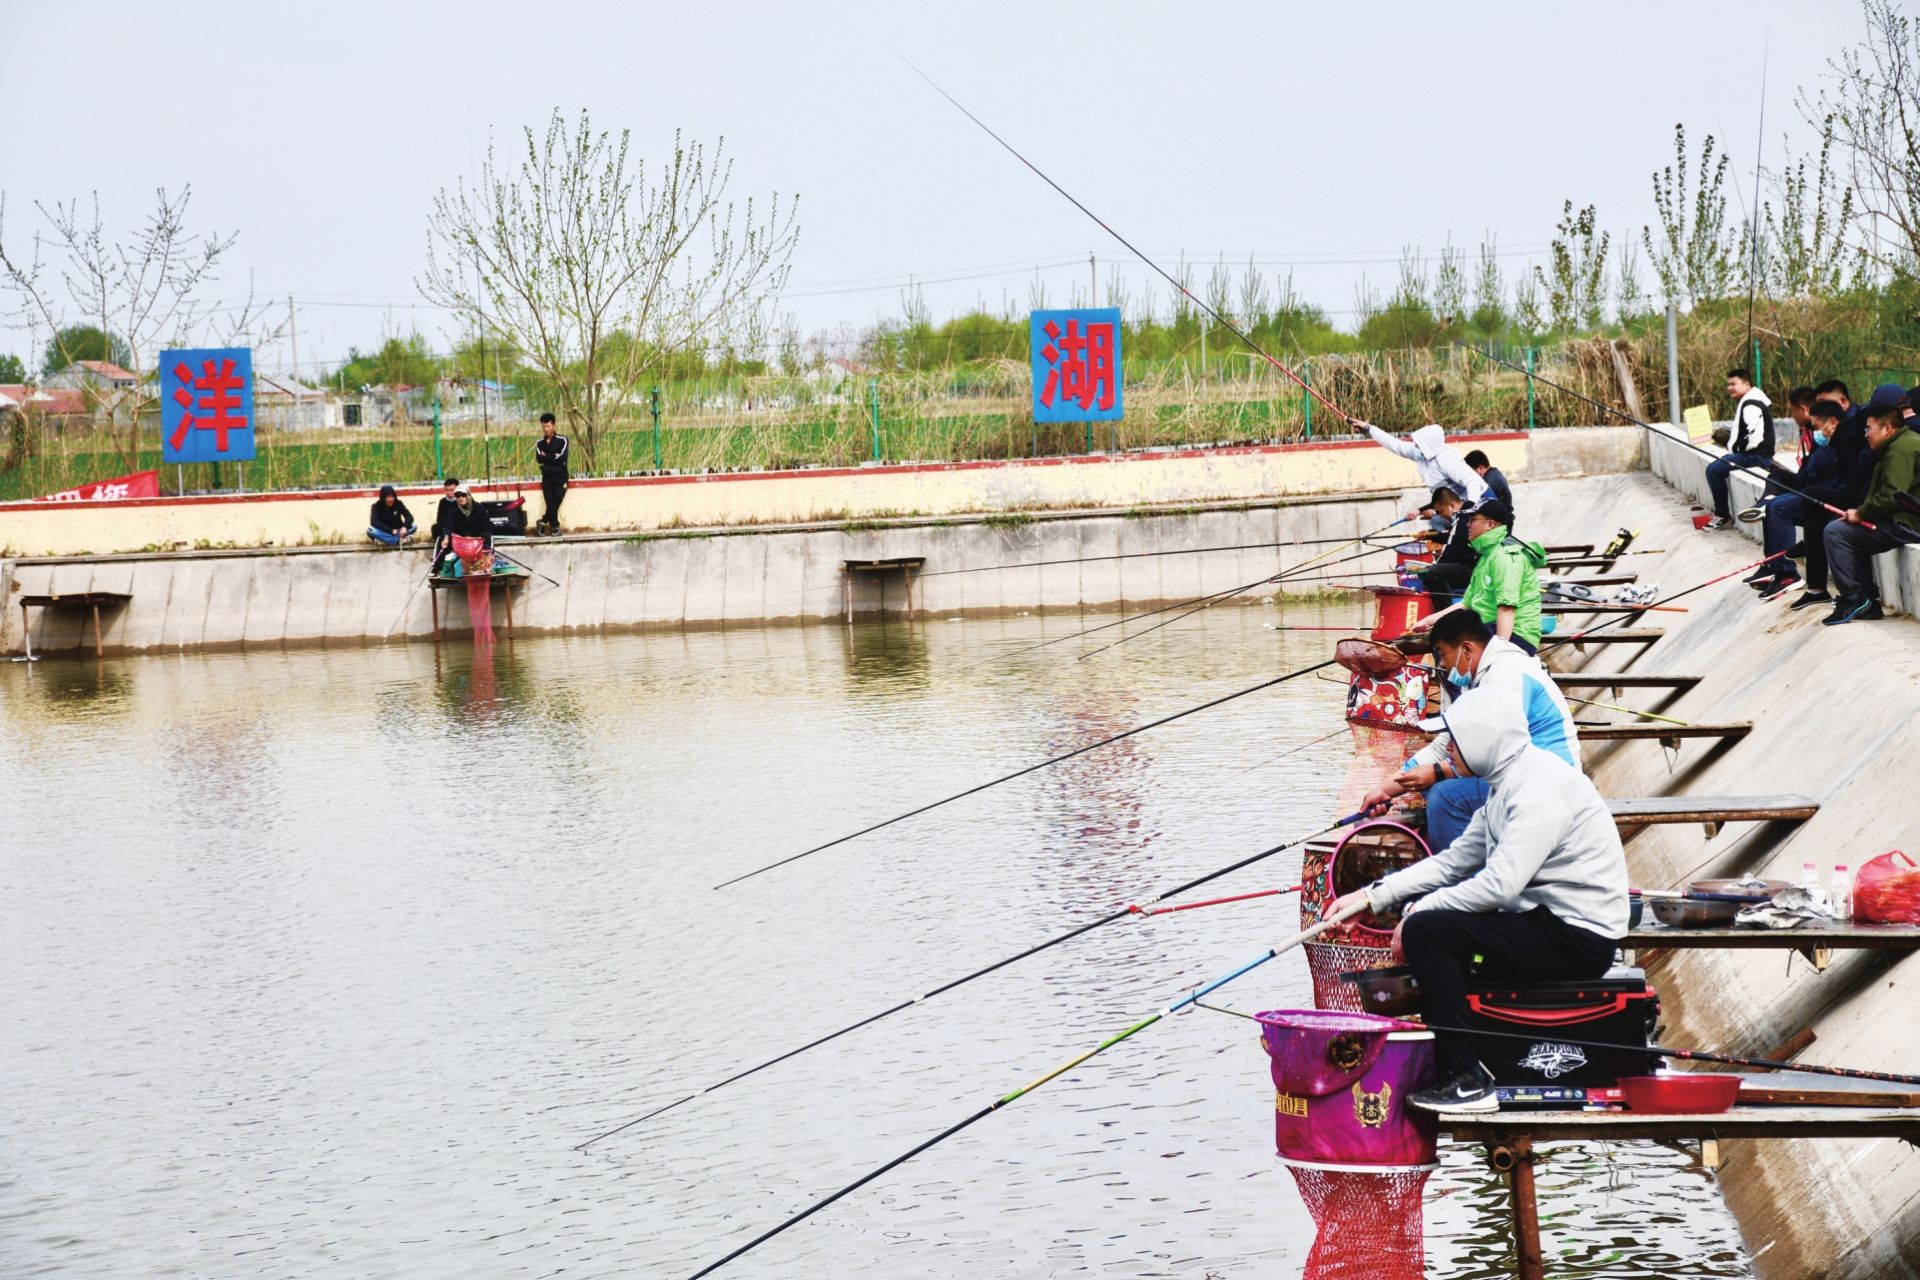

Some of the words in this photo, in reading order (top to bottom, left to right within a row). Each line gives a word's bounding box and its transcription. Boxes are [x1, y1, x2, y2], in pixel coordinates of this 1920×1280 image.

[170, 358, 248, 452] 洋
[1040, 319, 1114, 411] 湖
[1528, 1043, 1586, 1058] CHAMPIONS
